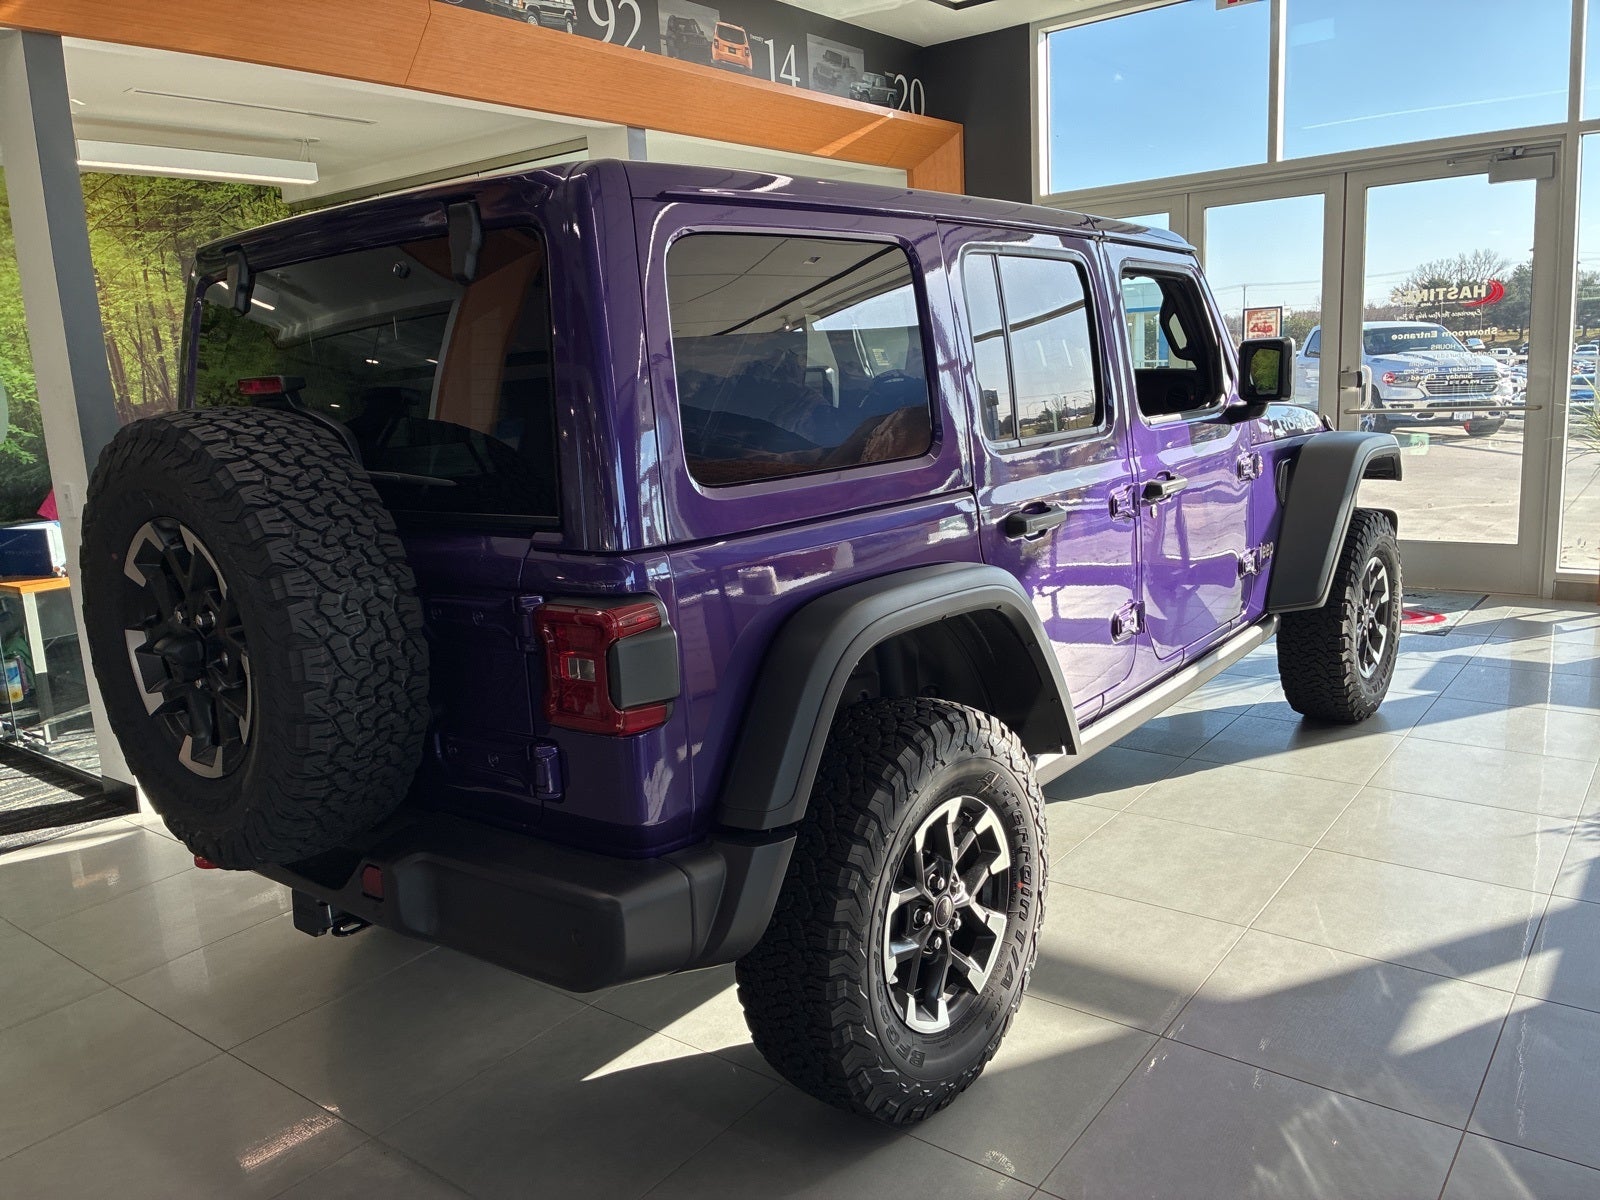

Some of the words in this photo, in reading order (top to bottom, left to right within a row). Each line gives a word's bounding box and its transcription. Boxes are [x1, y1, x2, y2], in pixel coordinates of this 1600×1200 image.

[587, 0, 646, 52] 92
[764, 39, 800, 87] 14
[894, 74, 925, 116] 20
